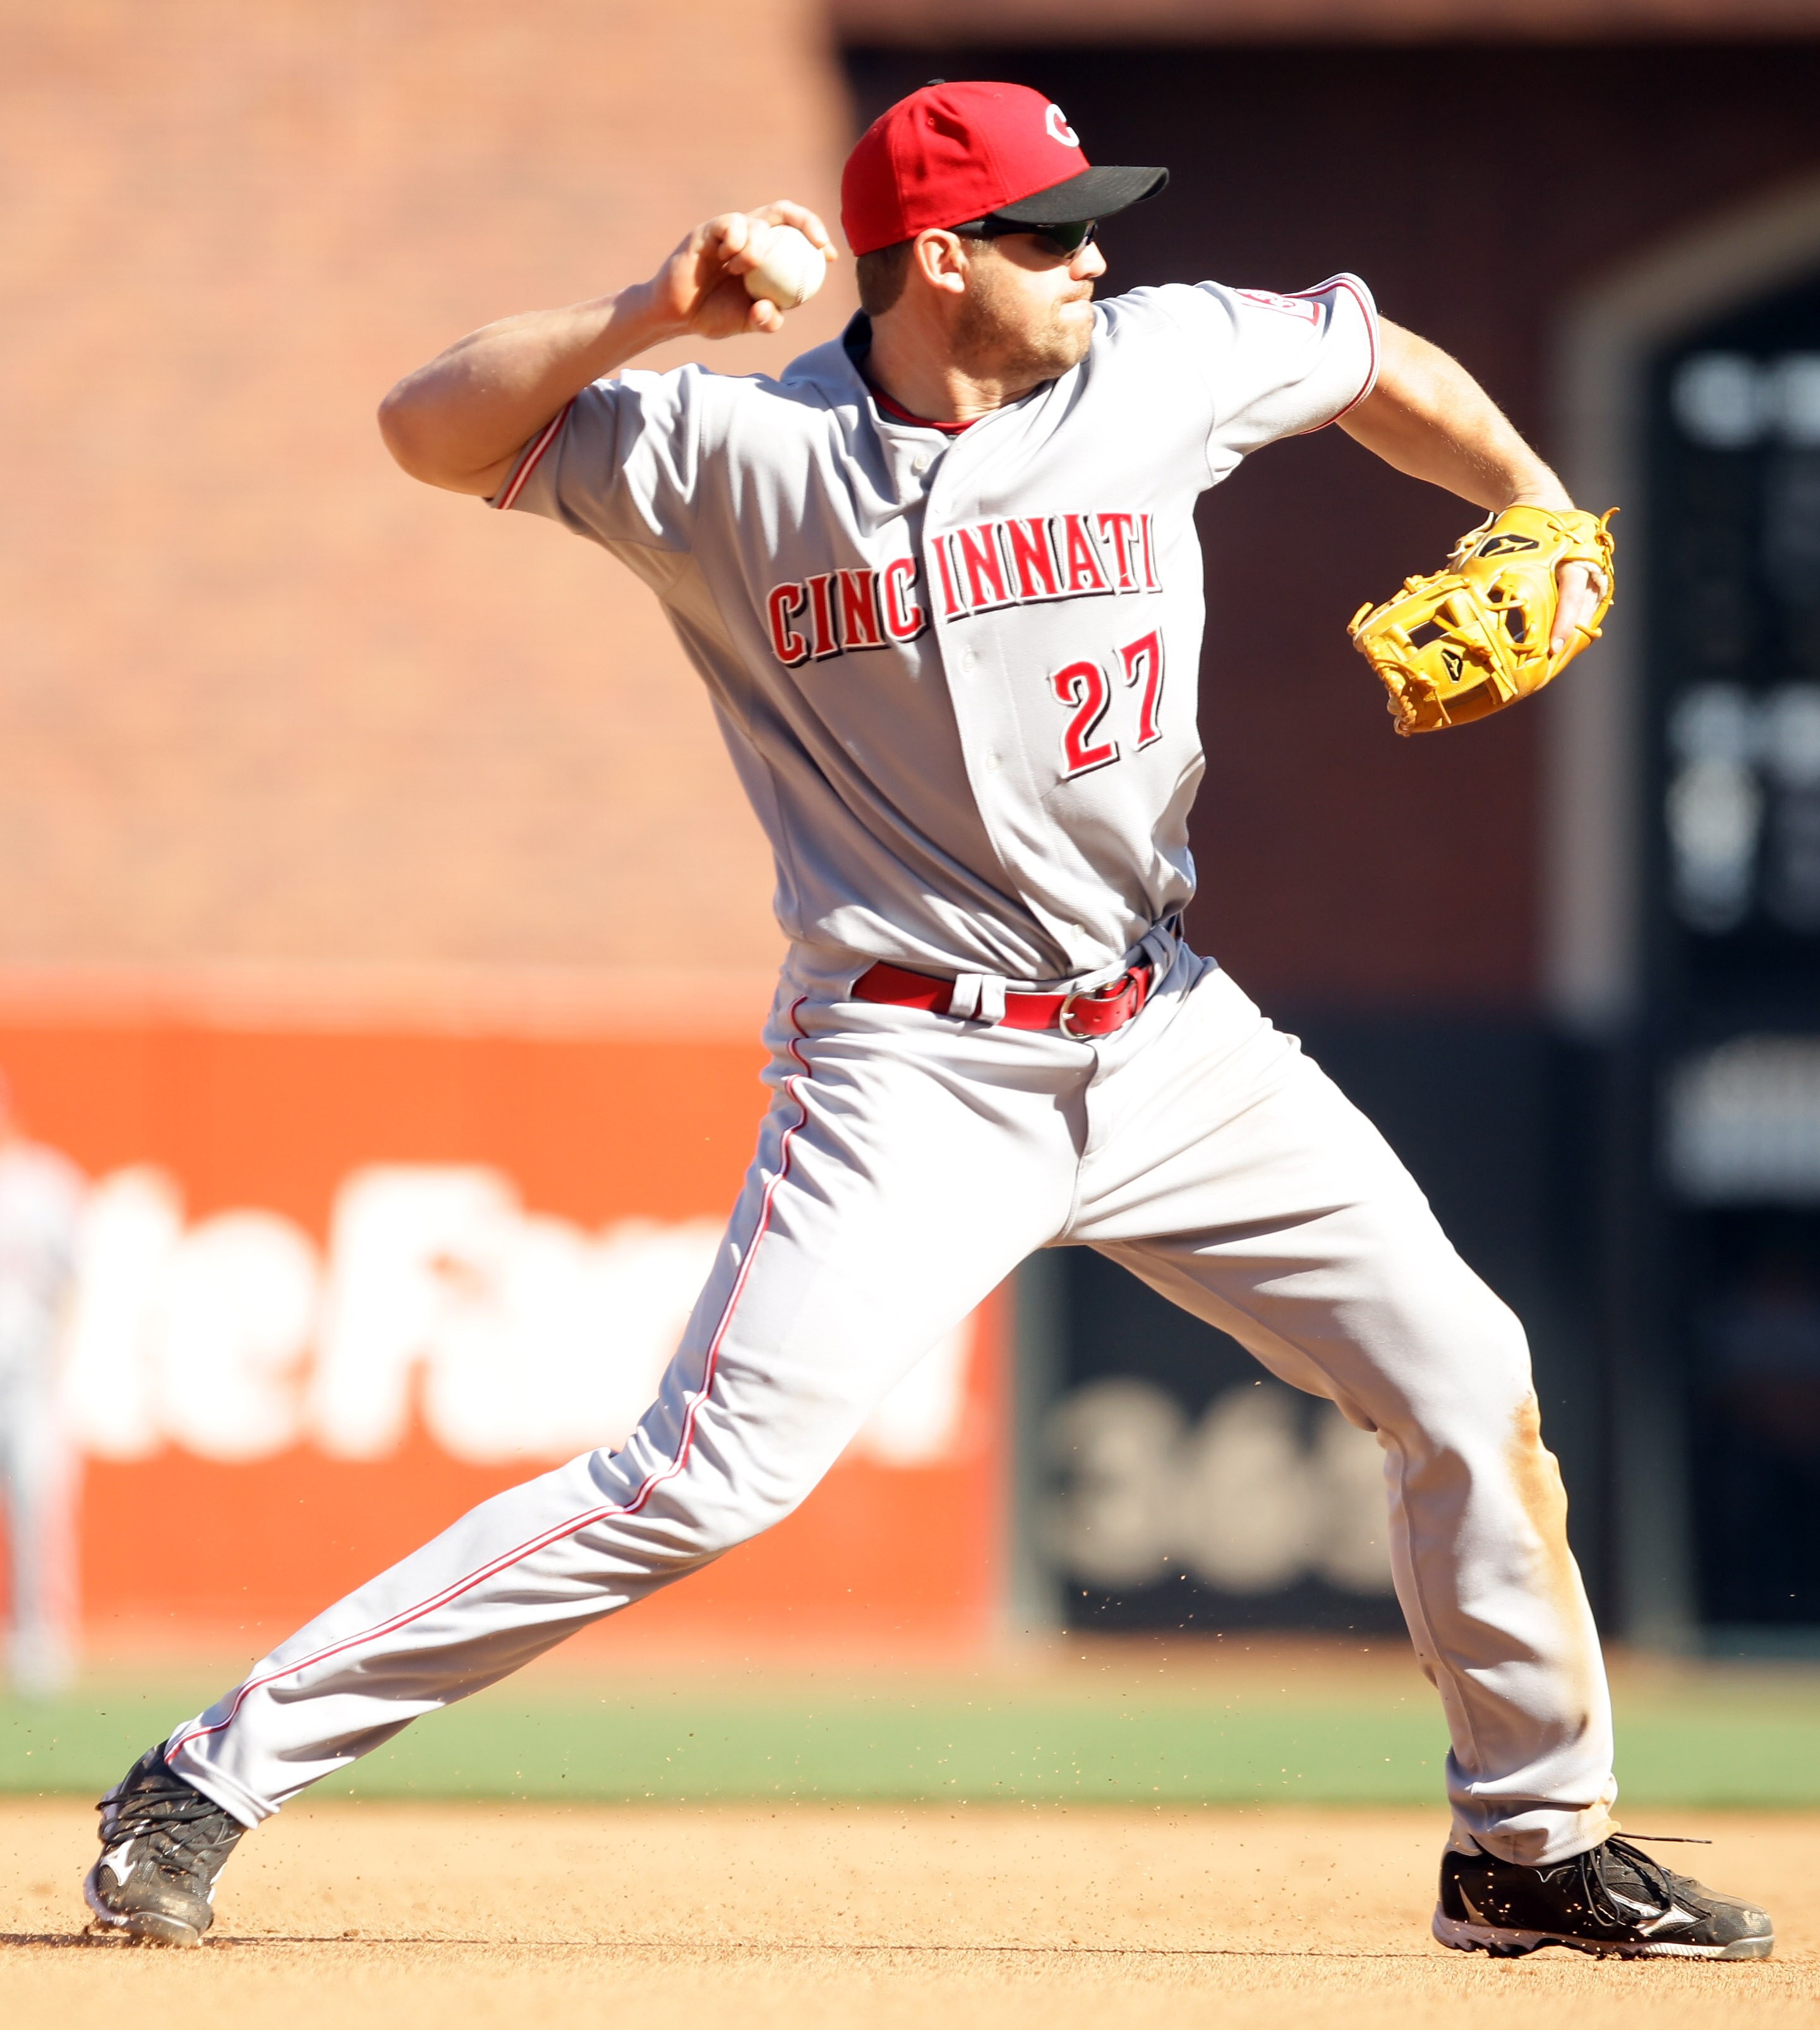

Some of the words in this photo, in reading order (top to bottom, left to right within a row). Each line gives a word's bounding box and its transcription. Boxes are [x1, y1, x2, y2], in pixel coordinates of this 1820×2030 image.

[1045, 103, 1080, 148] C
[766, 512, 1162, 668] CINCINNATI
[1050, 626, 1164, 781] 27
